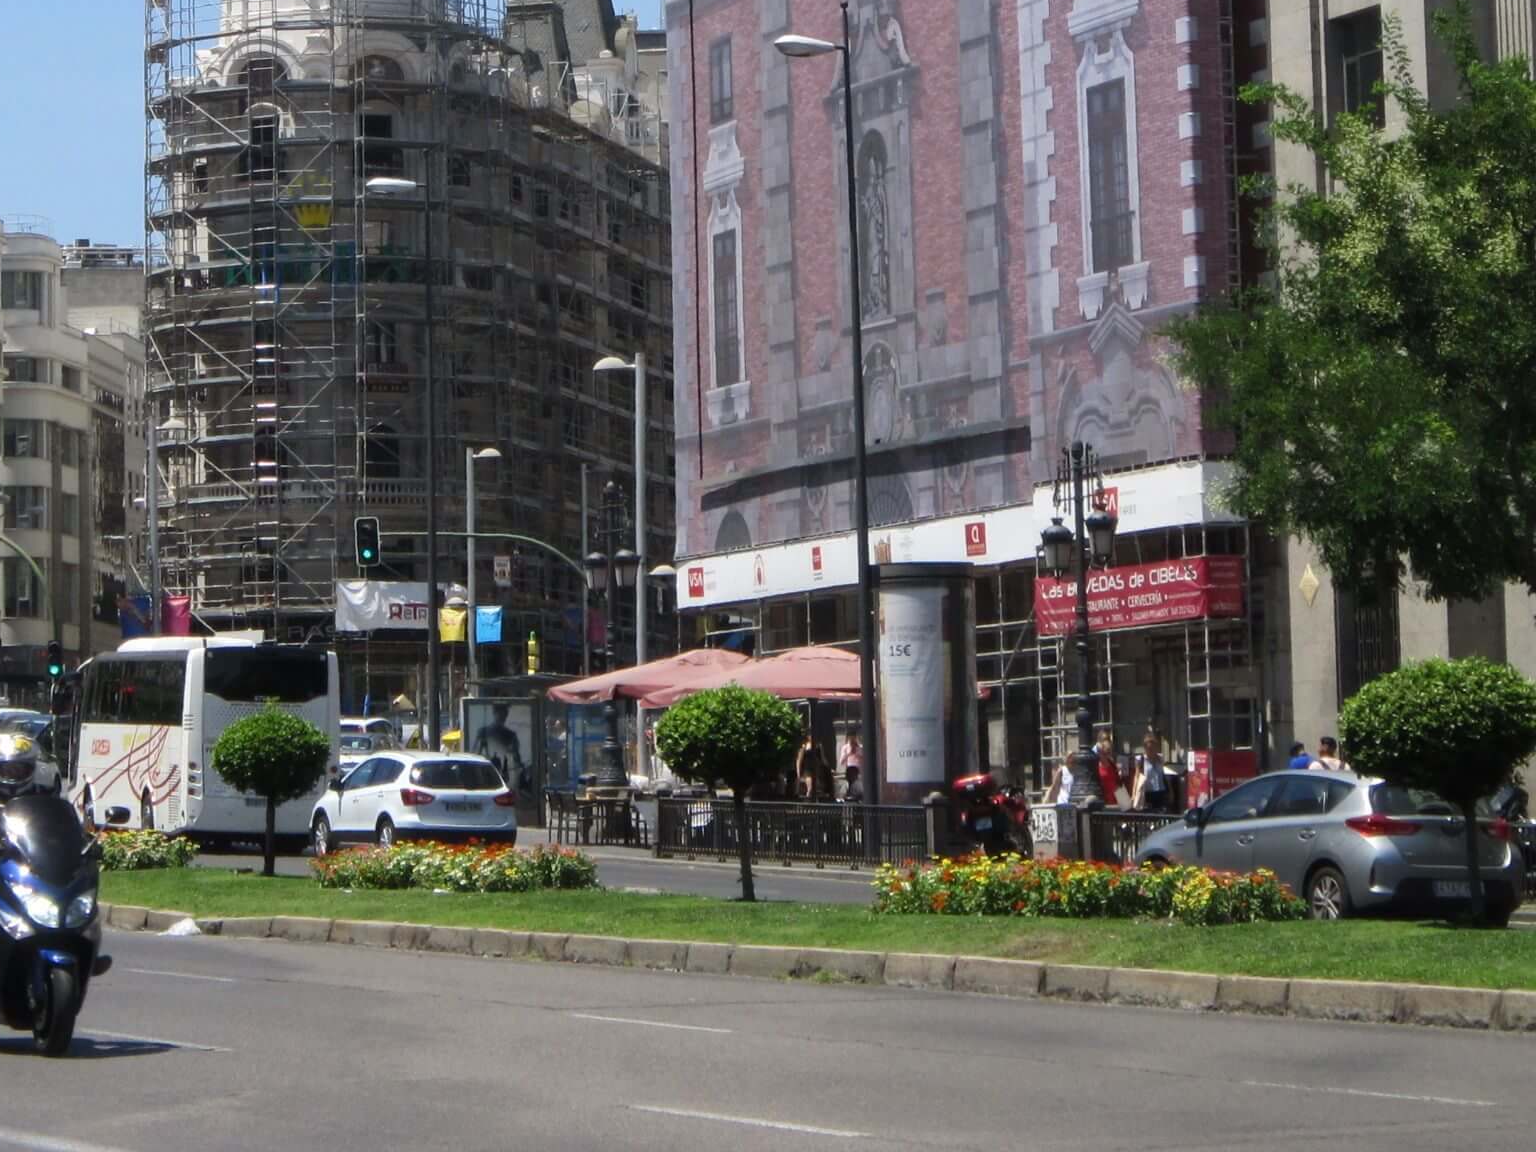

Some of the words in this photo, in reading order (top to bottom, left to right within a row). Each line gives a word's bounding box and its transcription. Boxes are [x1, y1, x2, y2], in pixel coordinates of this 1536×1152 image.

[1066, 574, 1124, 597] BVEDAS
[1128, 572, 1145, 589] de
[889, 644, 912, 657] 15€
